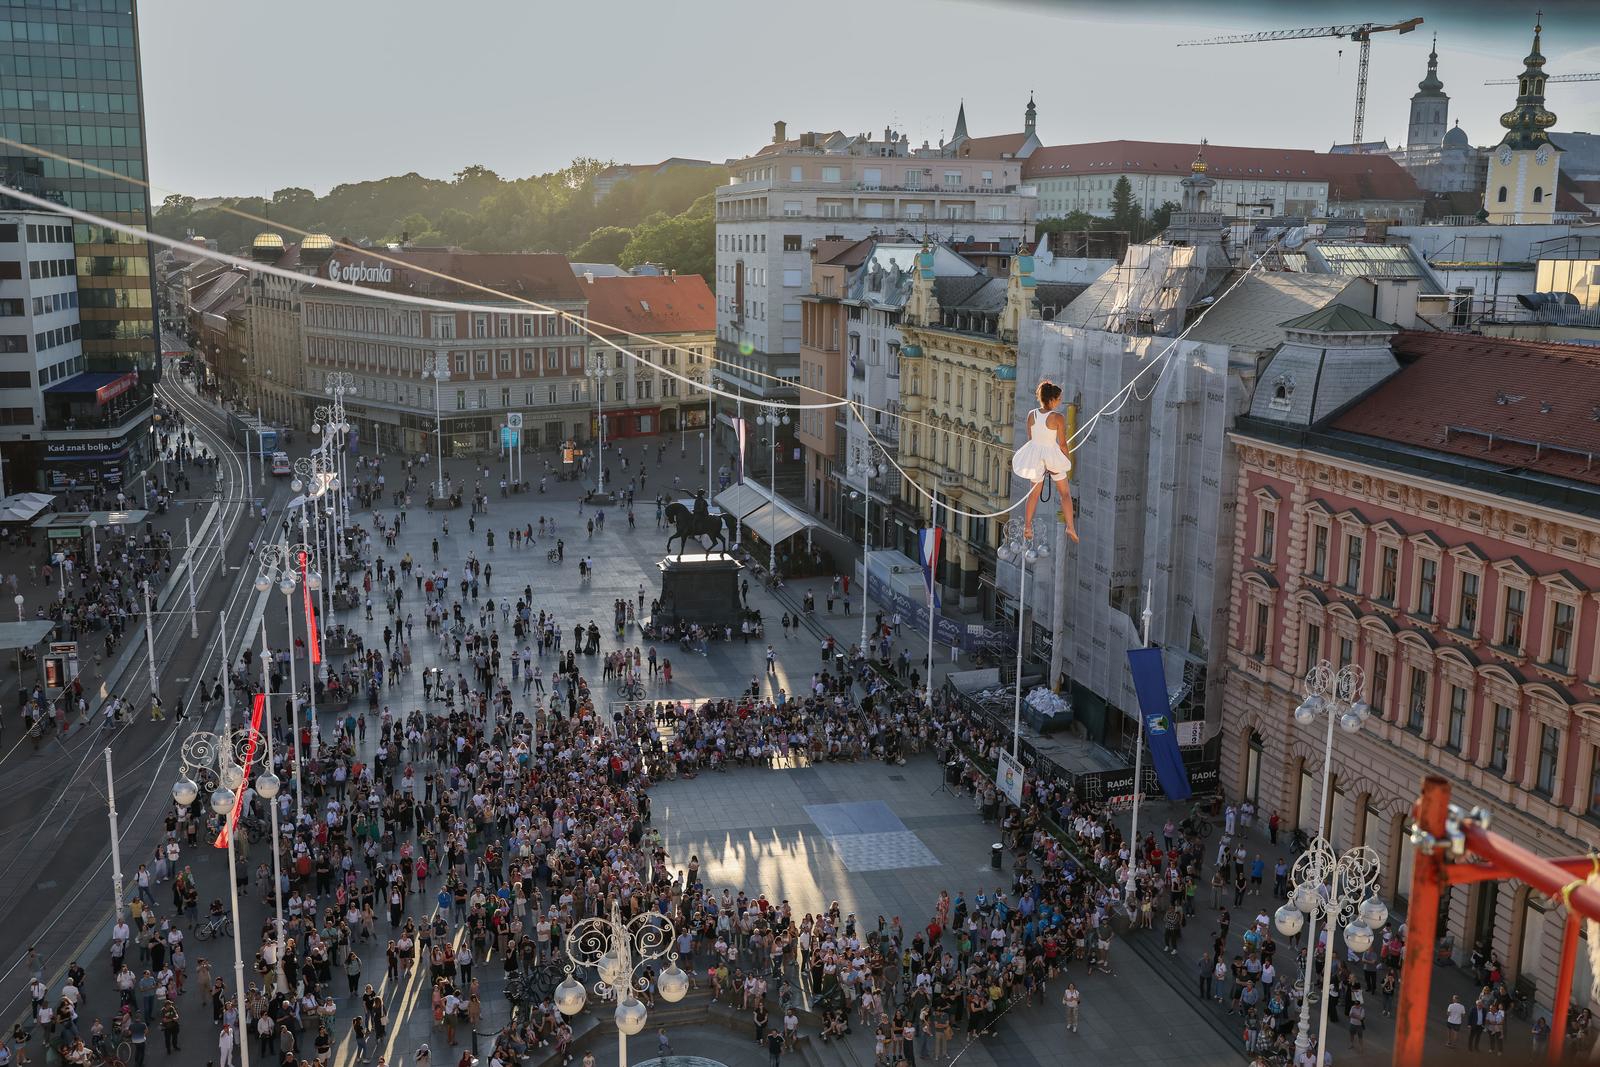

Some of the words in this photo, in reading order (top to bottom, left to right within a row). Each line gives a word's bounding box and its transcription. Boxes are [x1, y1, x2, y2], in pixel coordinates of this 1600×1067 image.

[47, 444, 65, 452] Kad
[87, 443, 111, 452] bolje,
[1191, 769, 1217, 780] RADIĆ
[1107, 776, 1133, 789] RADIĆ
